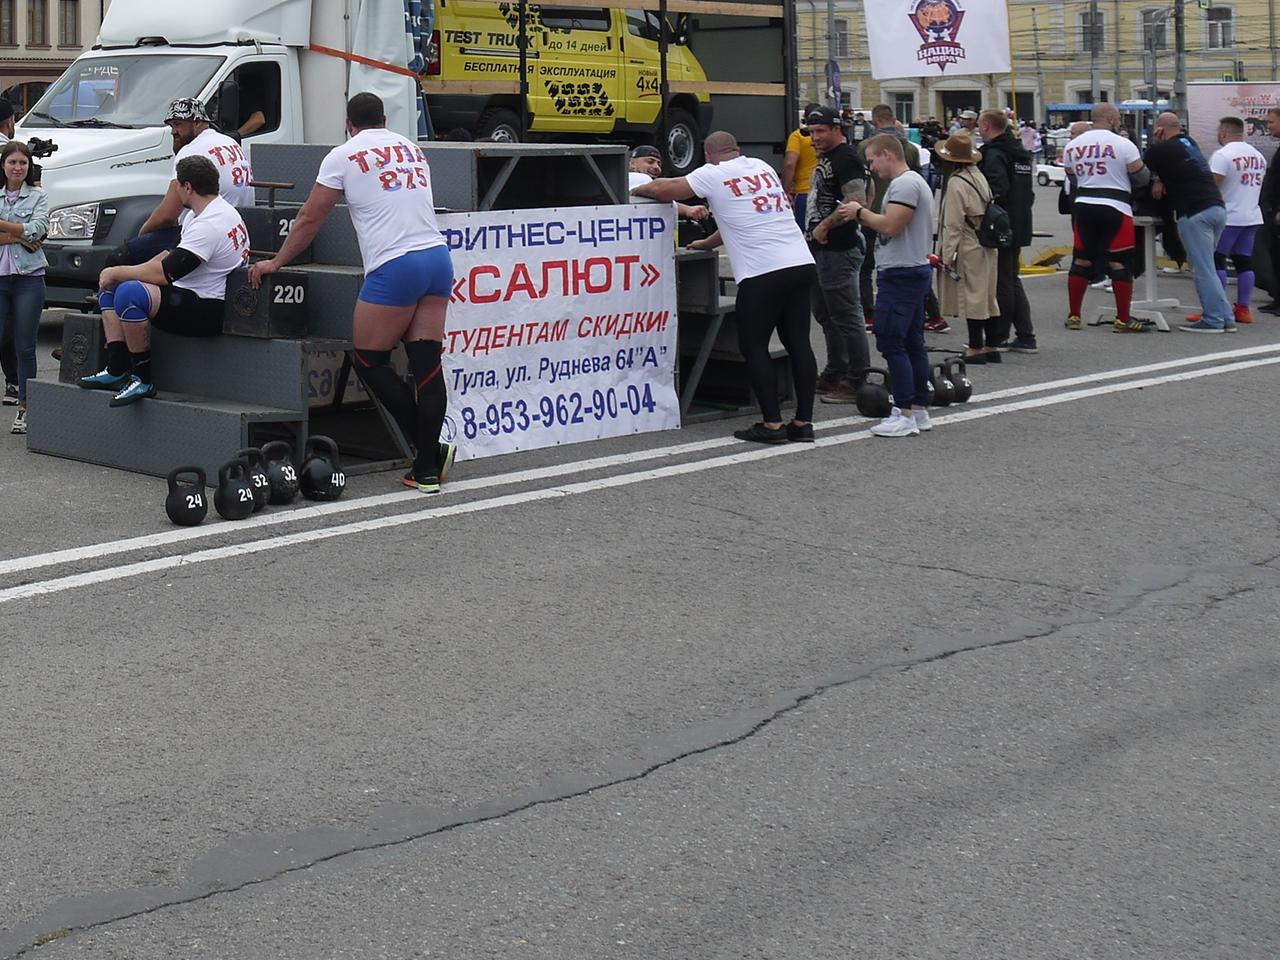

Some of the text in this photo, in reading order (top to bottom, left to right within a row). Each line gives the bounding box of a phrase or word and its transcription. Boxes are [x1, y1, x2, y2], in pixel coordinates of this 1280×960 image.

[444, 29, 535, 49] TEST TRUK
[548, 39, 607, 53] до 14 дней
[918, 46, 965, 59] НАЦИЯ
[464, 61, 617, 80] БЕСПЛАТНЯ ЭКСПЛУАТАЦИЯ
[1066, 141, 1118, 162] ТУЛА
[1075, 160, 1108, 177] 875
[449, 255, 662, 304] «САЛЮТ»
[273, 285, 305, 303] 220
[577, 311, 670, 341] СКИДКИ!
[451, 366, 500, 395] Тула,
[505, 365, 531, 389] ул.
[538, 353, 611, 384] Руднева
[461, 383, 657, 439] 8-953-962-90-04
[252, 474, 269, 488] 32
[280, 466, 297, 481] 32
[331, 472, 346, 487] 40
[185, 493, 204, 508] 24
[238, 487, 254, 502] 24
